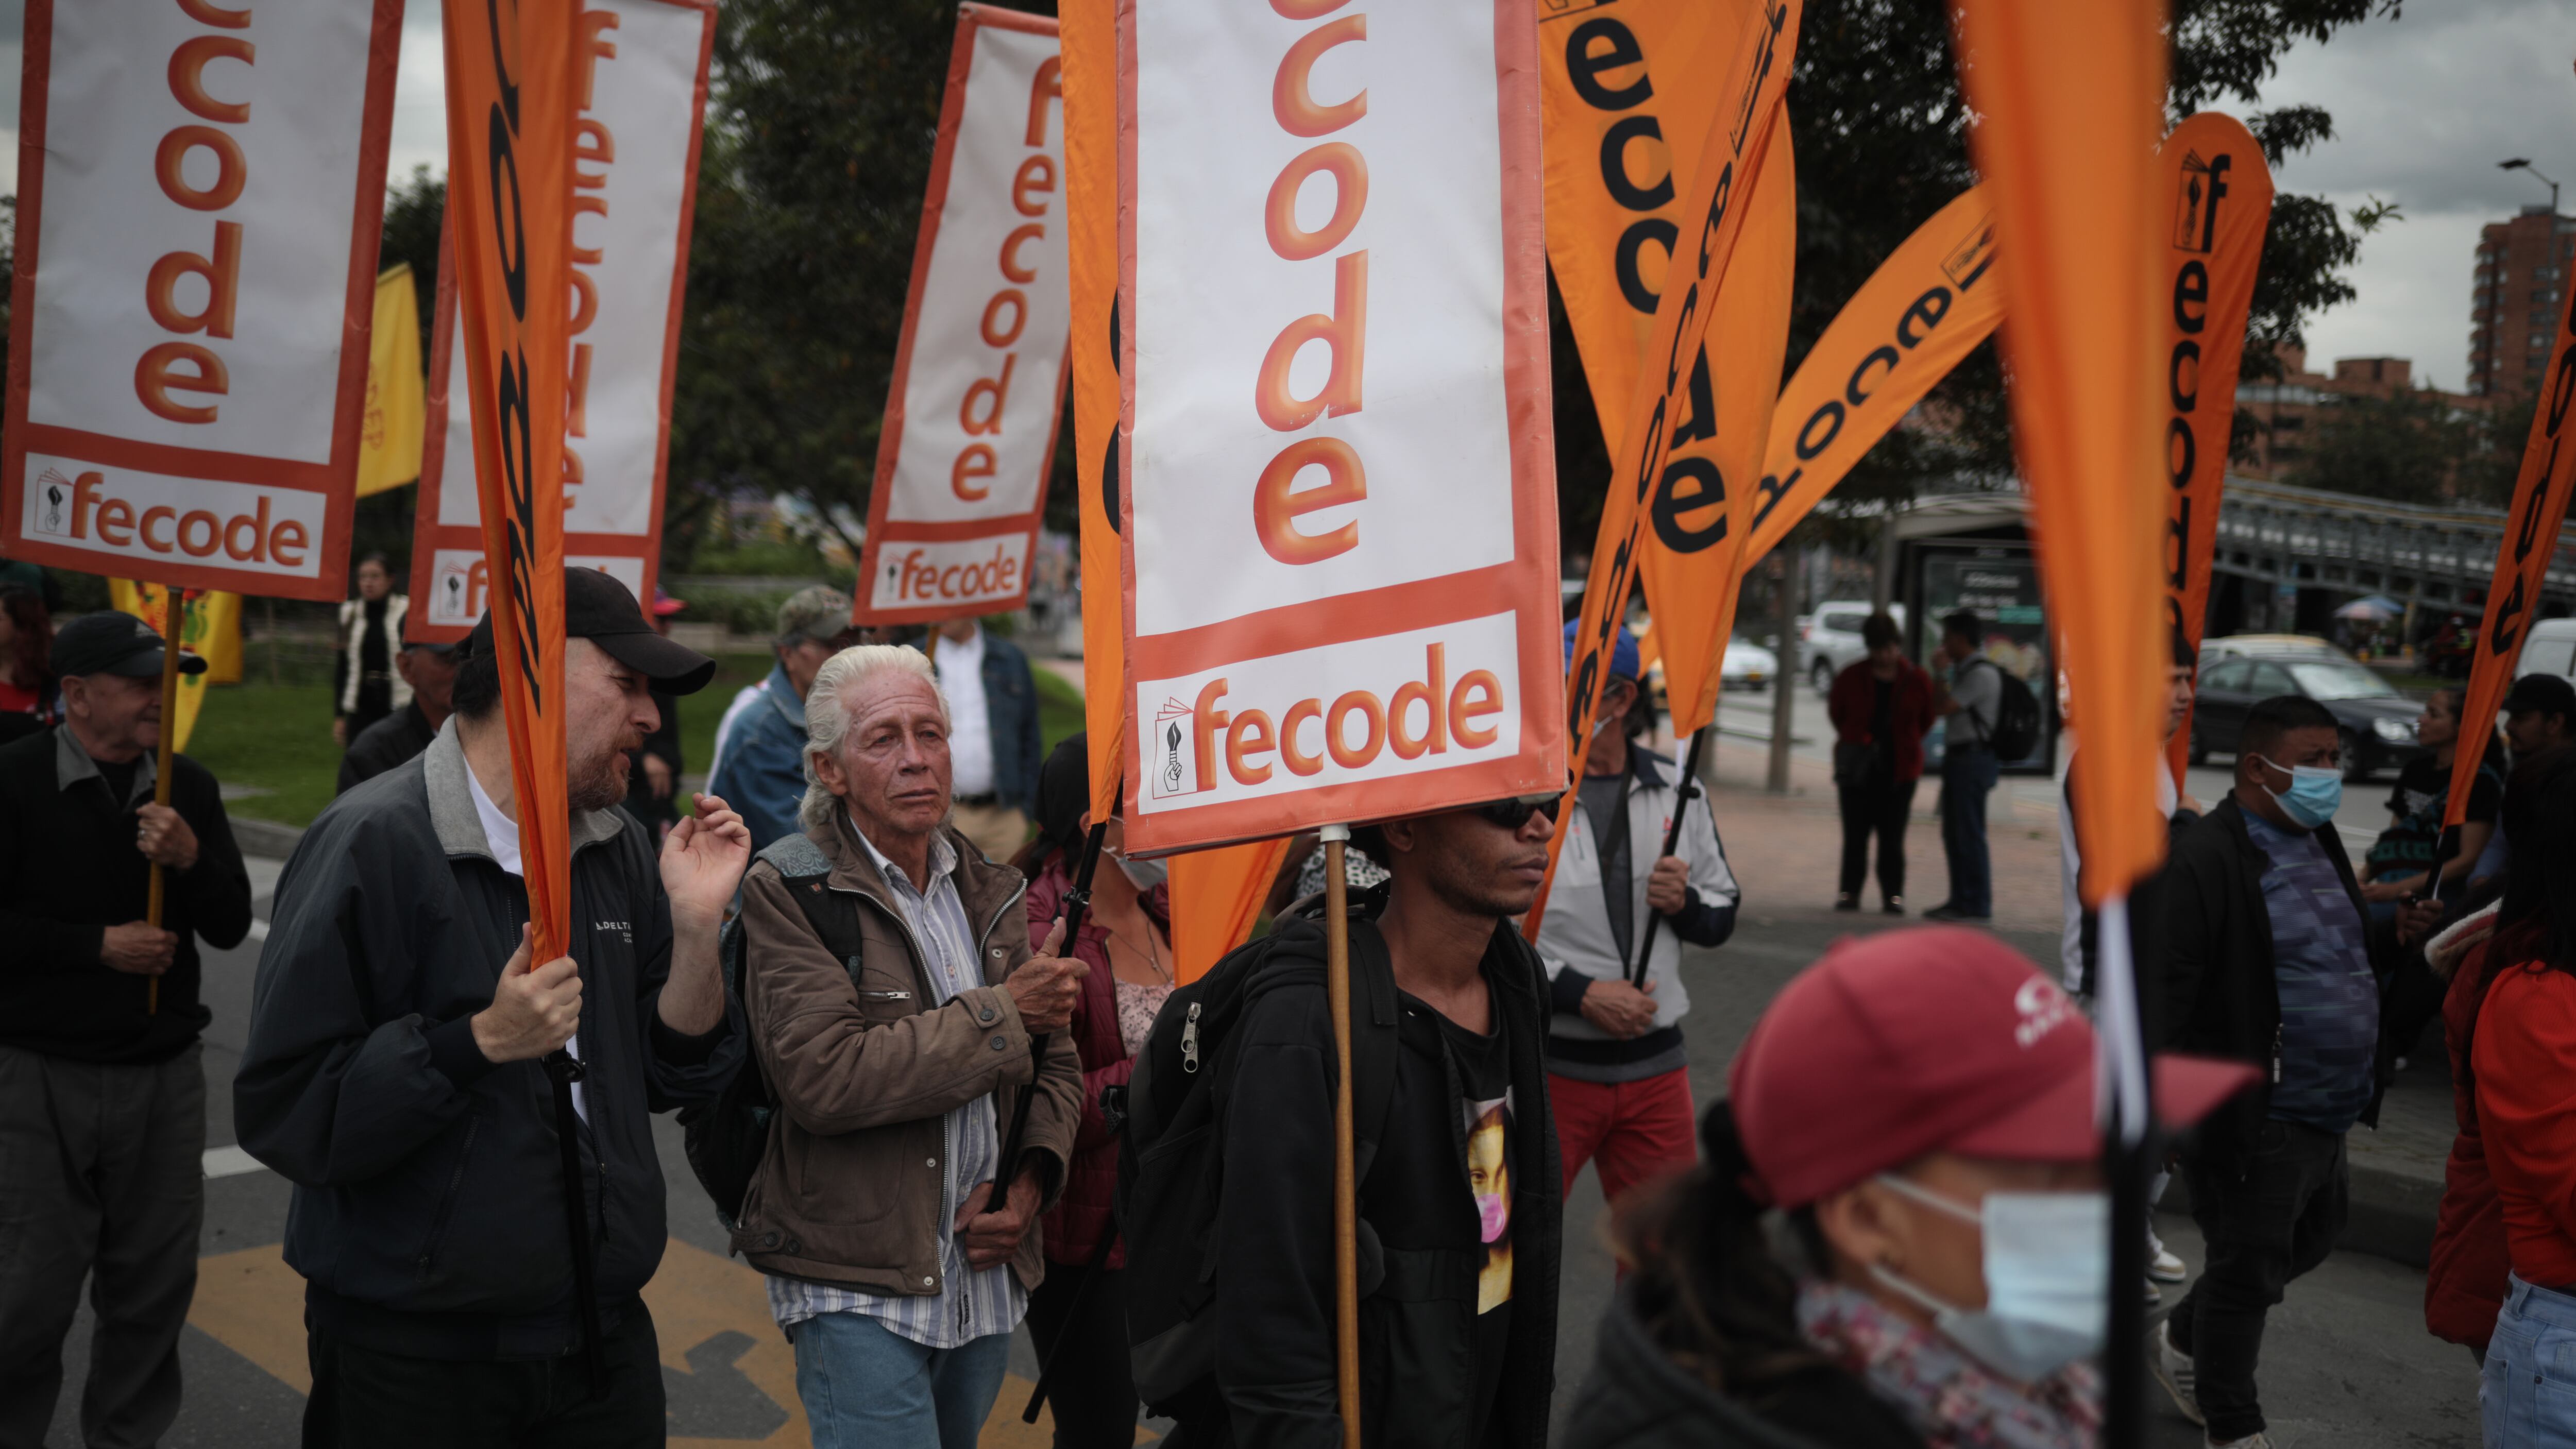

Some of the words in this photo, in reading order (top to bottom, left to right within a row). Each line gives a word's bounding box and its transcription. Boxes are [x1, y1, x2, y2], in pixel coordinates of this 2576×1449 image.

[134, 0, 256, 424] code
[951, 55, 1063, 502] fecode
[1253, 0, 1368, 566] code
[1566, 0, 1727, 554] ecoe
[2165, 154, 2231, 629] fecod
[71, 471, 309, 567] fecode
[899, 543, 1016, 601] fecode
[1193, 641, 1503, 790] fecode
